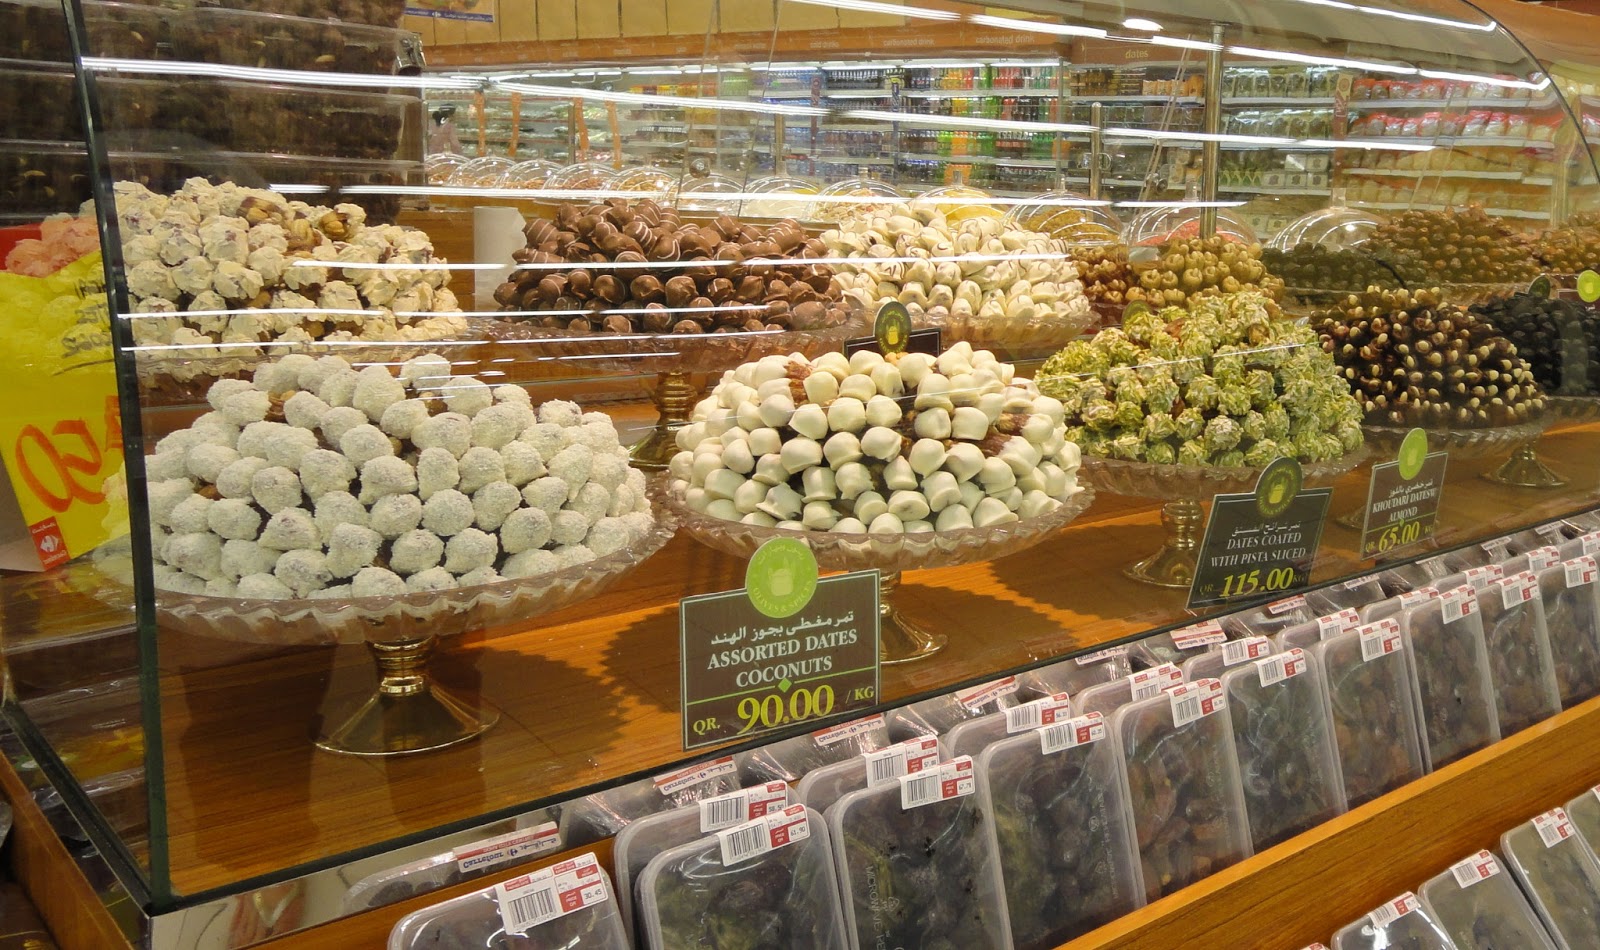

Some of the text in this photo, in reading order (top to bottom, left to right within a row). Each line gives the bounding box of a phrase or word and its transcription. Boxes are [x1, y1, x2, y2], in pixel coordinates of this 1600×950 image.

[883, 38, 935, 47] carbonated drink
[975, 33, 1035, 44] carbonated drink
[1125, 49, 1148, 59] dates
[1388, 507, 1418, 523] ALMOND
[1226, 532, 1302, 550] DATES COATED
[1379, 521, 1419, 552] 65.00
[1211, 547, 1306, 567] WITH PISTA SLICED
[1219, 567, 1294, 597] 115.00
[834, 611, 854, 627] تمر
[711, 626, 747, 645] الهند
[751, 625, 784, 641] بجوز
[707, 629, 858, 669] ASSORTED DATES
[736, 655, 833, 687] COCONUTS
[693, 717, 721, 735] QR.
[737, 684, 835, 735] 90.00
[584, 888, 602, 900] 30.45
[865, 865, 882, 932] MICROWAVE
